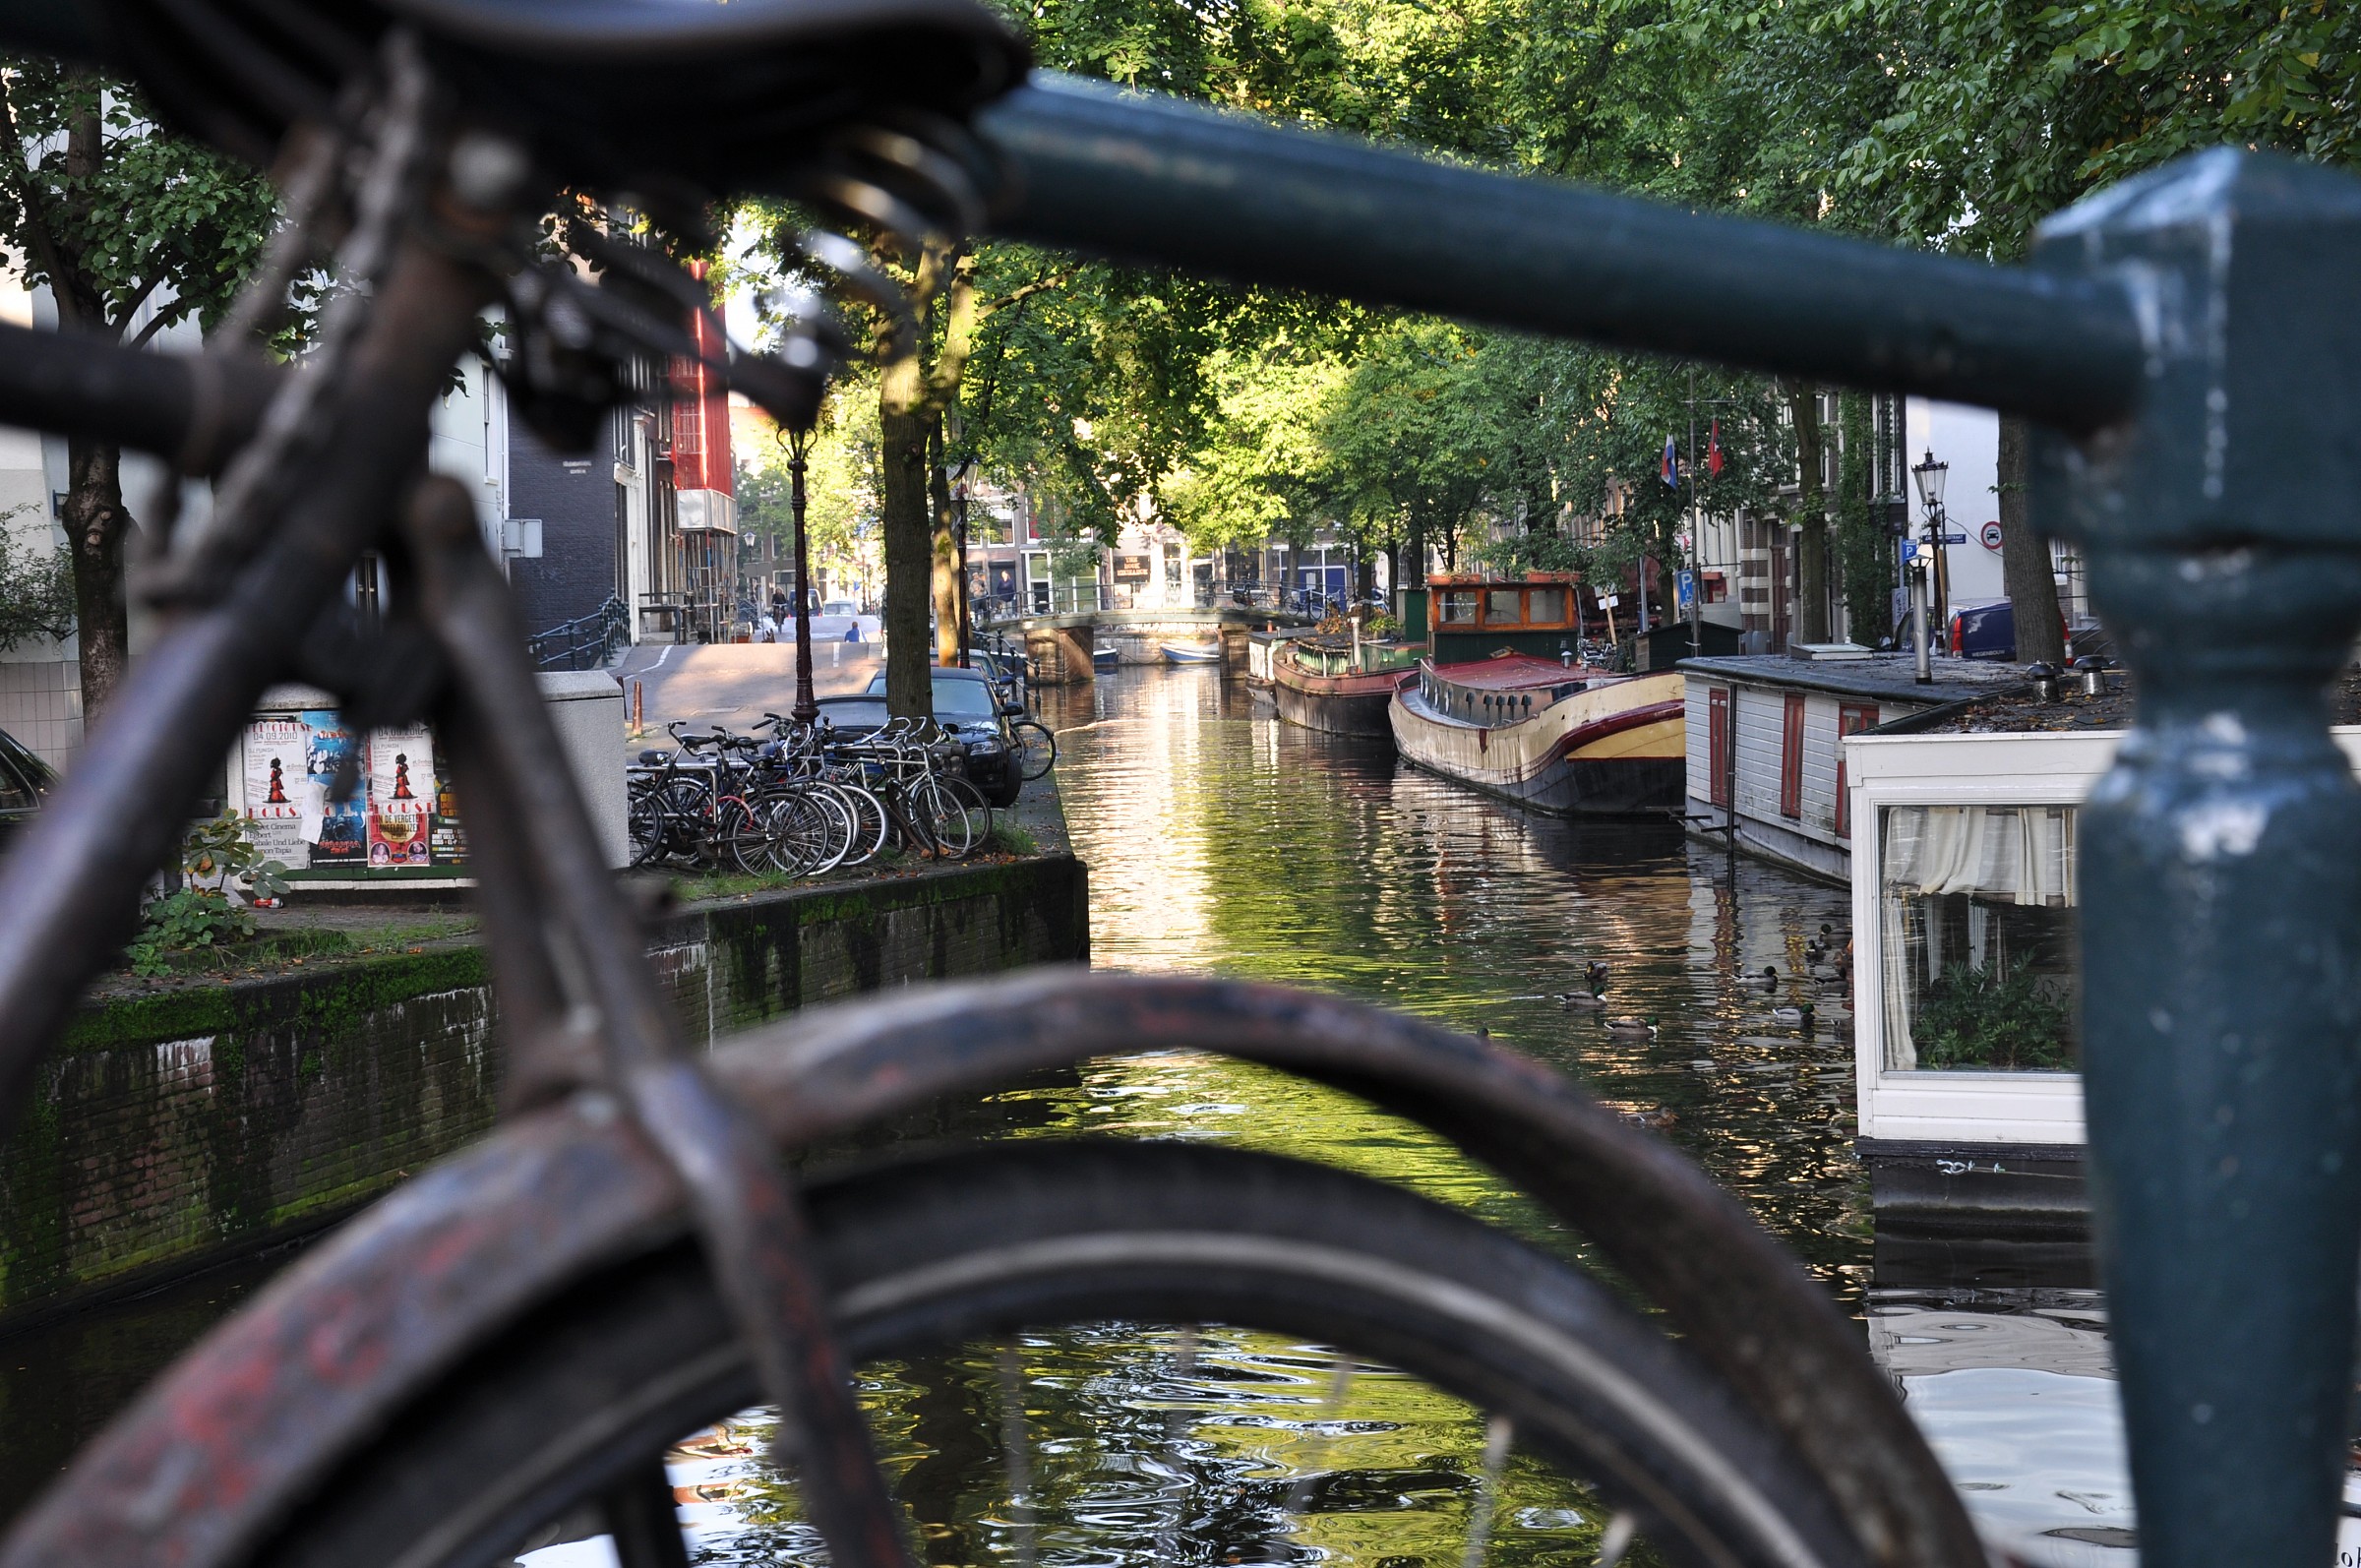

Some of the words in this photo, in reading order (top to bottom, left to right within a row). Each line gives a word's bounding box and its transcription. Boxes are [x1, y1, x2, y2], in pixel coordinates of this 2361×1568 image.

[1907, 546, 1913, 556] P
[1680, 573, 1693, 590] P
[253, 732, 298, 741] 04.09.2010
